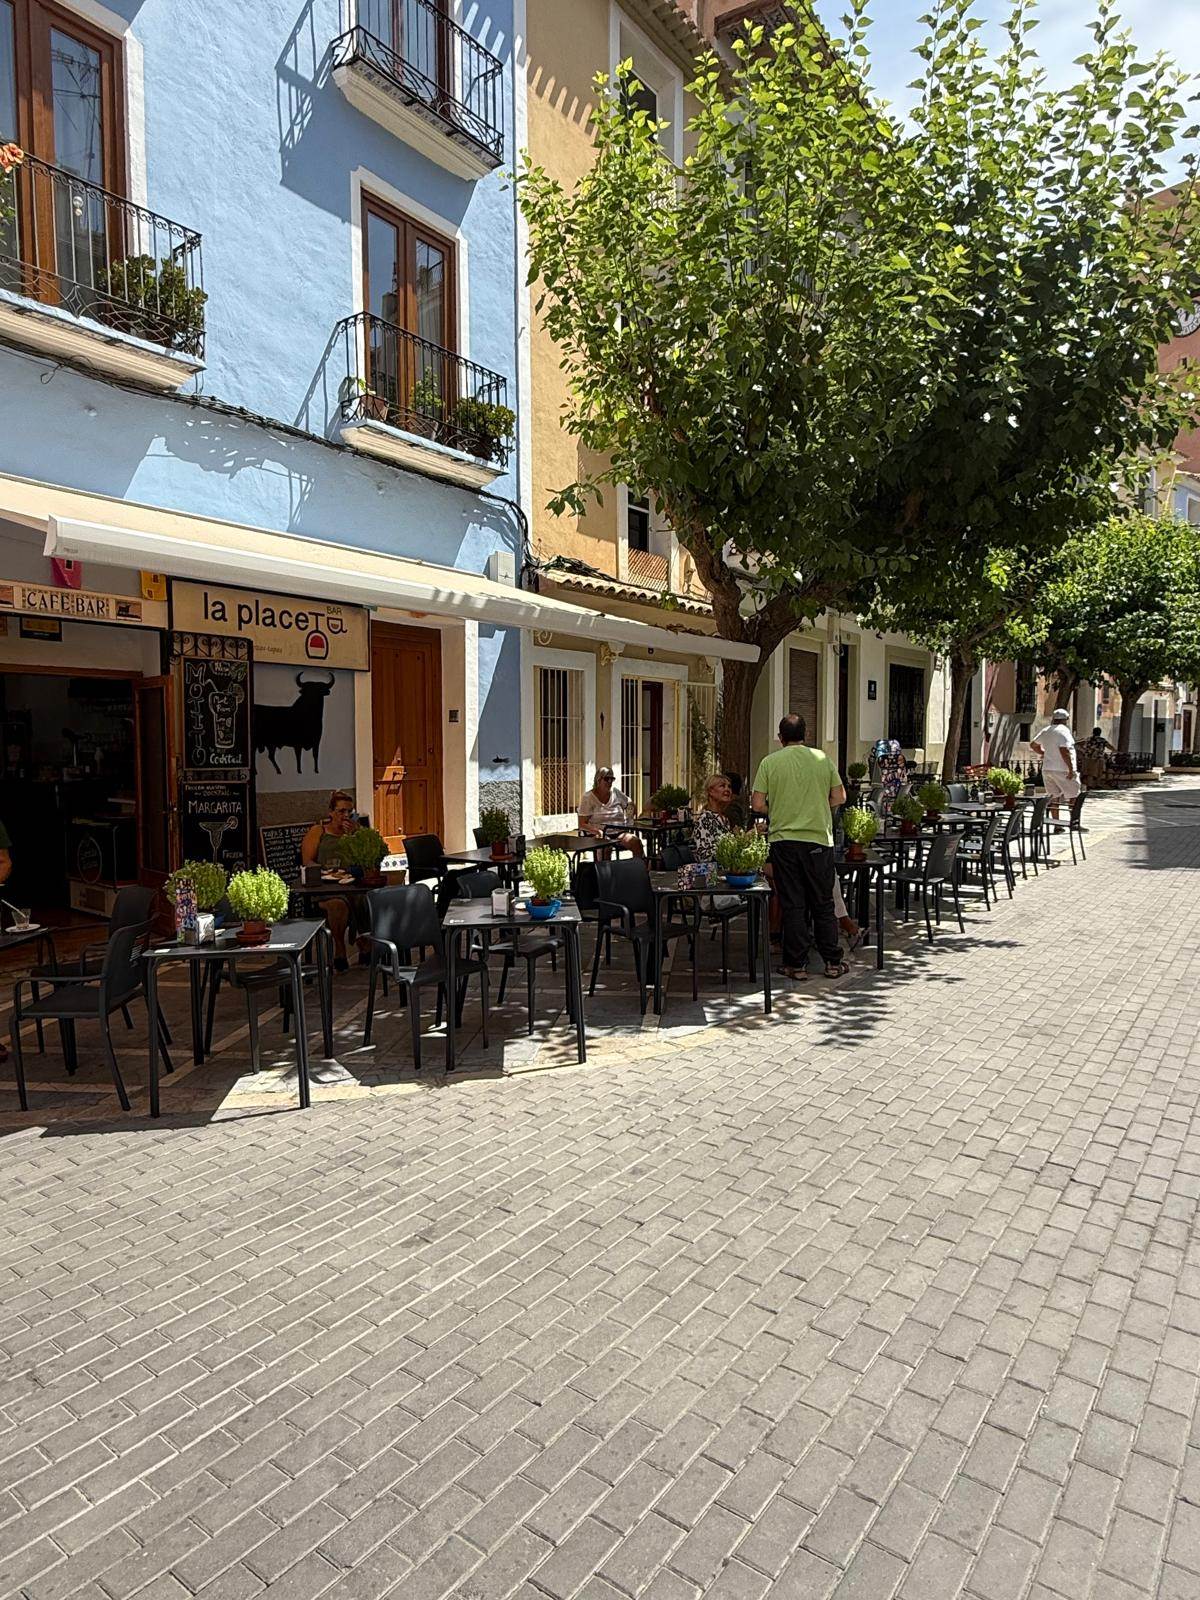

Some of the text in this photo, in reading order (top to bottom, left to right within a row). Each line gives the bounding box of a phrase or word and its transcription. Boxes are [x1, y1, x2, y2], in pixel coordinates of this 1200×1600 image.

[76, 597, 105, 614] BAR
[204, 592, 228, 622] la
[326, 606, 342, 614] BAR
[209, 753, 242, 764] Cocktail
[188, 800, 242, 814] MARGARITA
